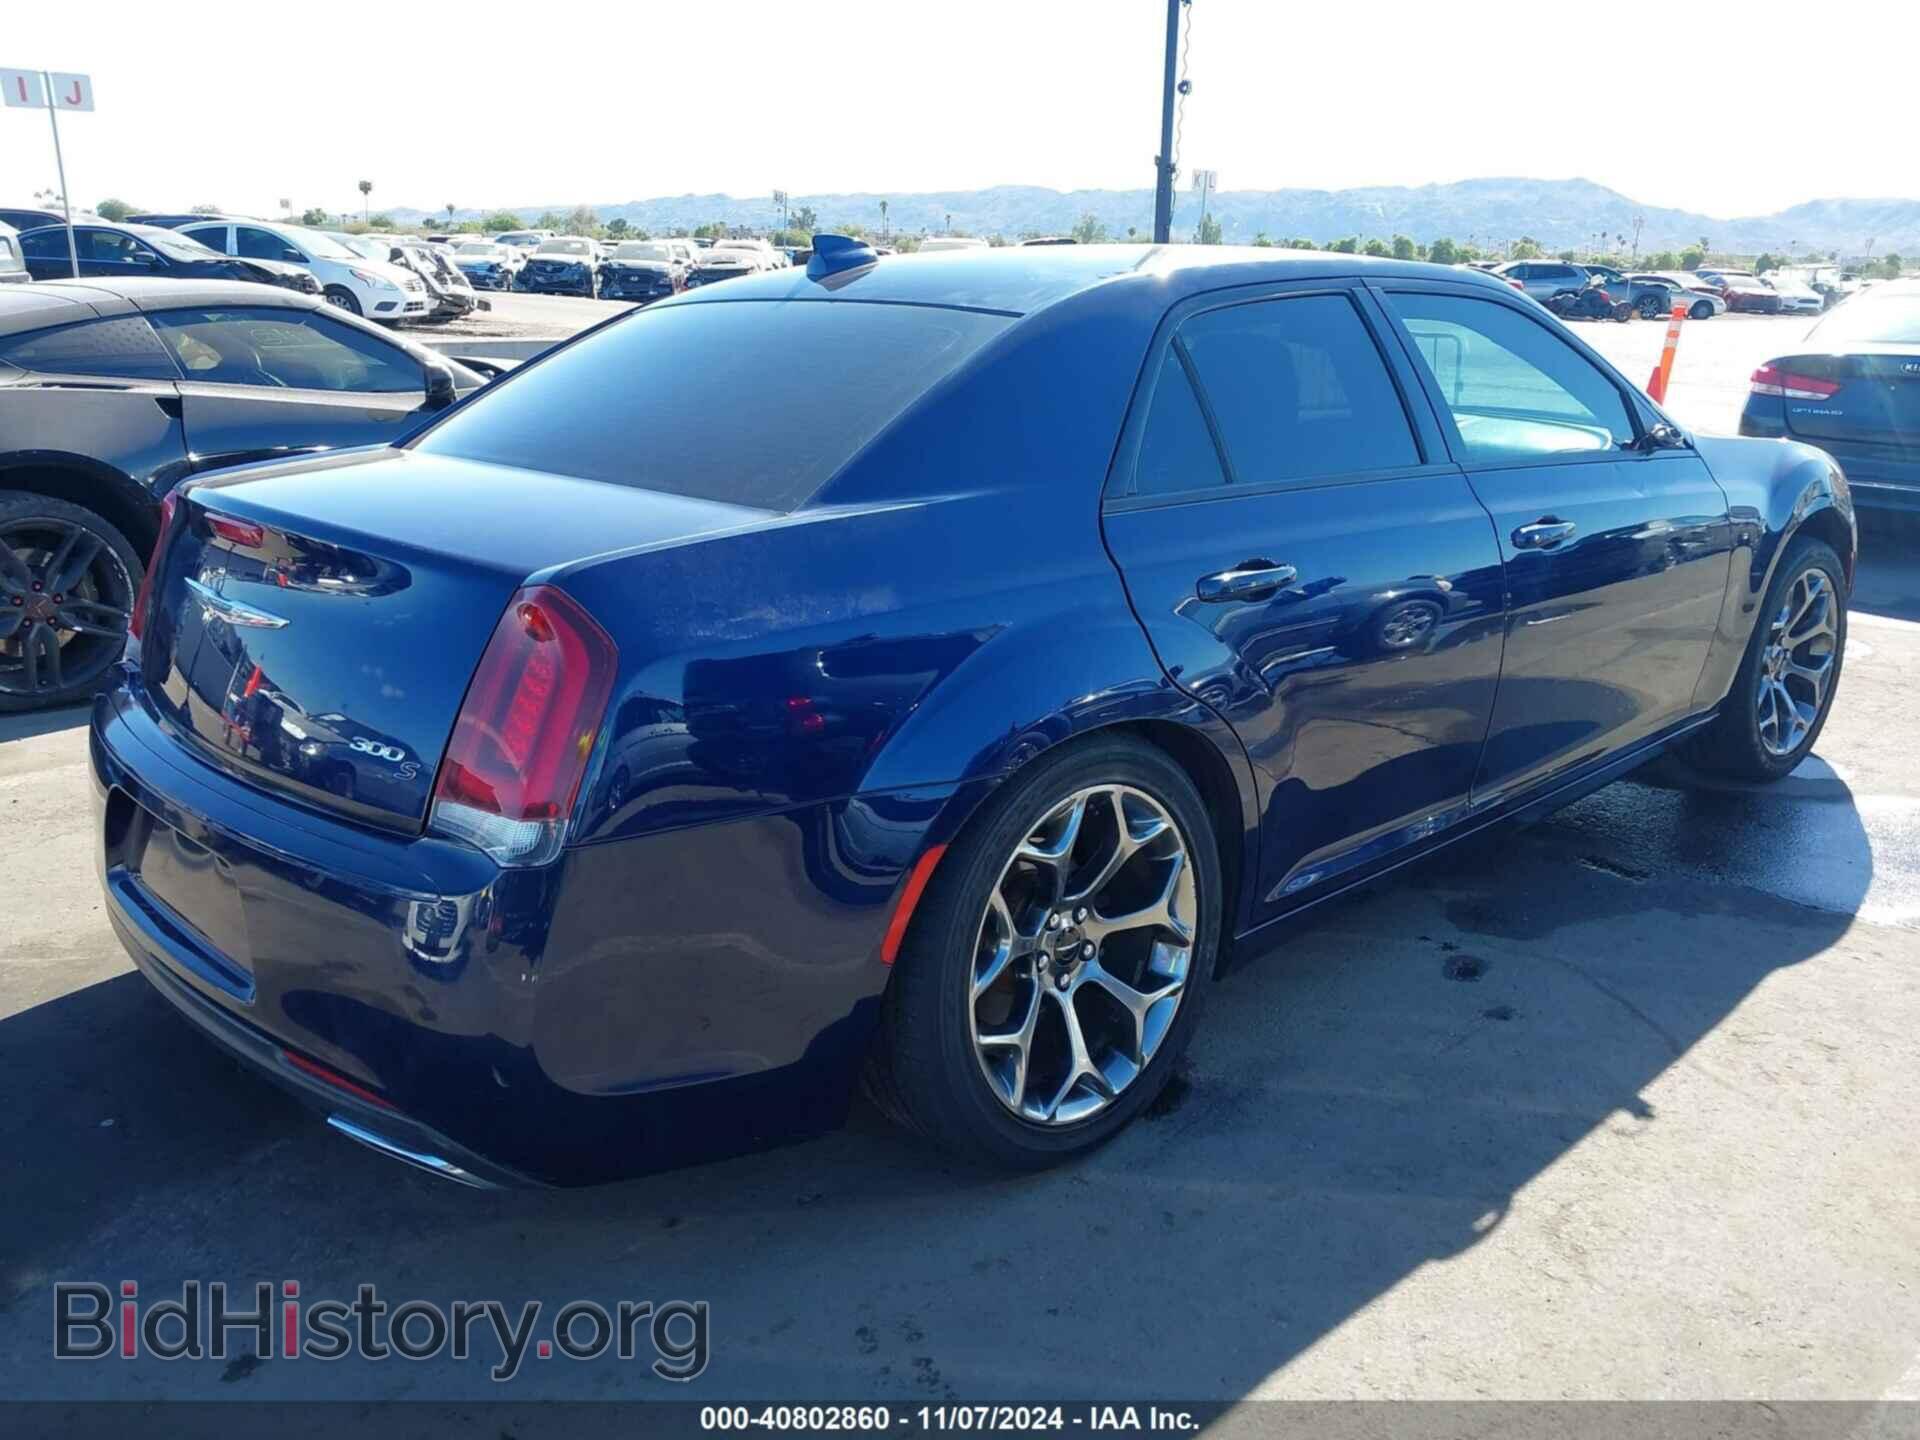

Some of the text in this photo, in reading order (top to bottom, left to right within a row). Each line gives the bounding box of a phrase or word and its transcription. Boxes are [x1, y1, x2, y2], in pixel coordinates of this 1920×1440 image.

[17, 76, 27, 102] I
[64, 80, 82, 105] J
[349, 736, 405, 762] 300
[393, 761, 421, 781] S
